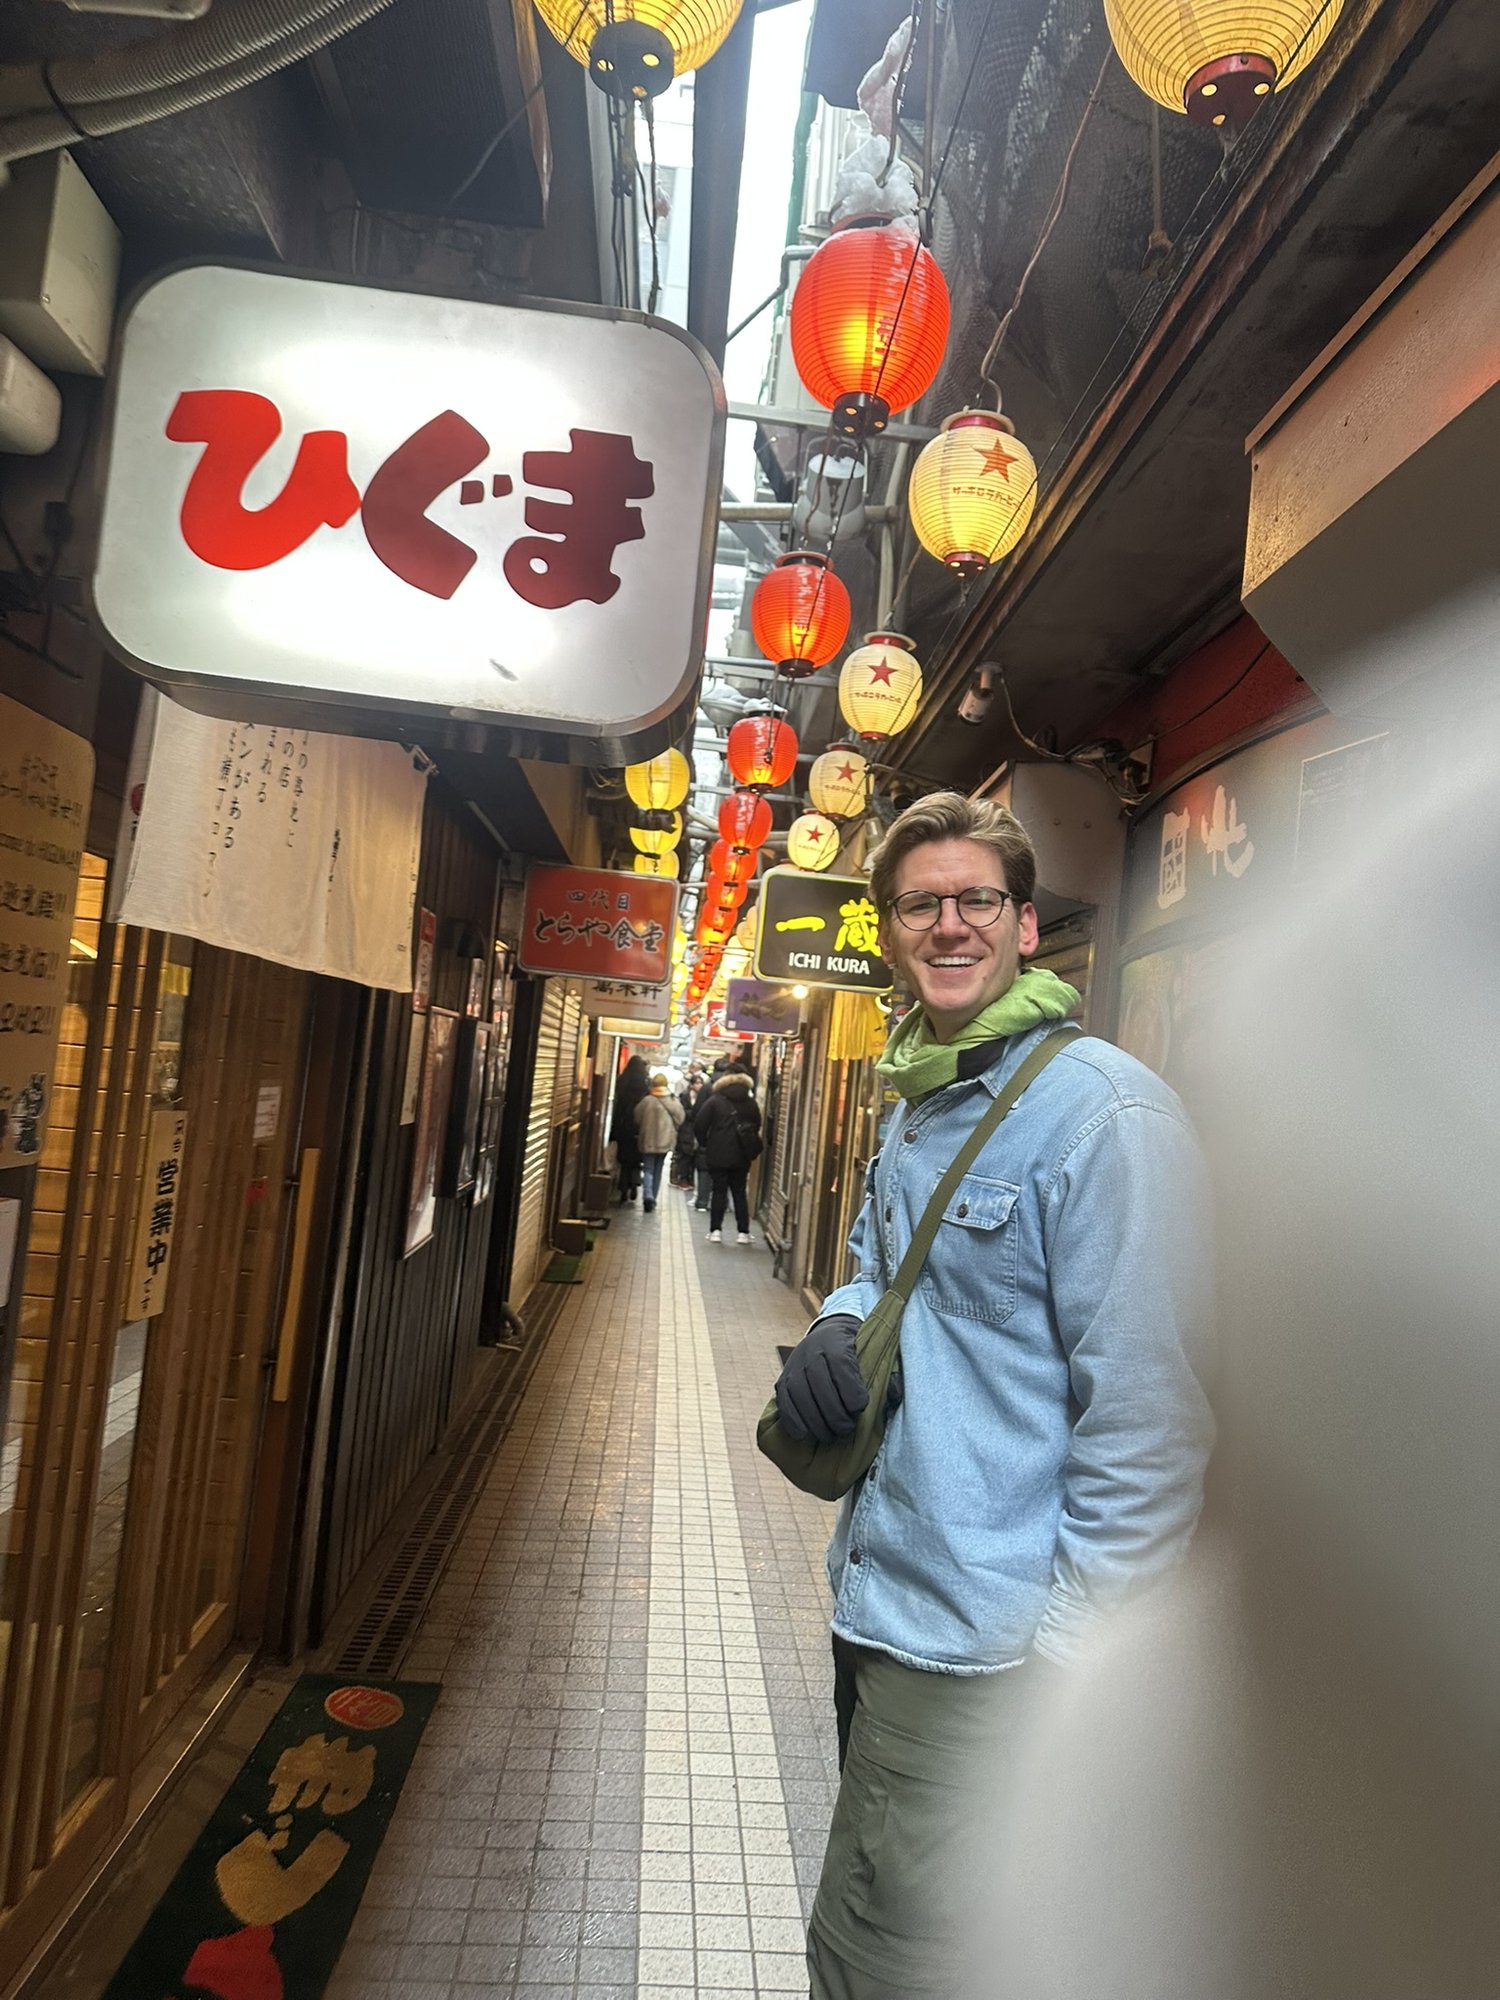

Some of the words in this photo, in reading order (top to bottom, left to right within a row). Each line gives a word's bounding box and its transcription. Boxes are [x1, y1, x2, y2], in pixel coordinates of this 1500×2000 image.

[166, 389, 654, 610] ひぐま
[567, 888, 631, 911] 四代目
[534, 908, 665, 953] とらや食堂
[775, 897, 882, 957] 一蔵
[788, 951, 821, 969] ICHI
[826, 956, 871, 975] KURA
